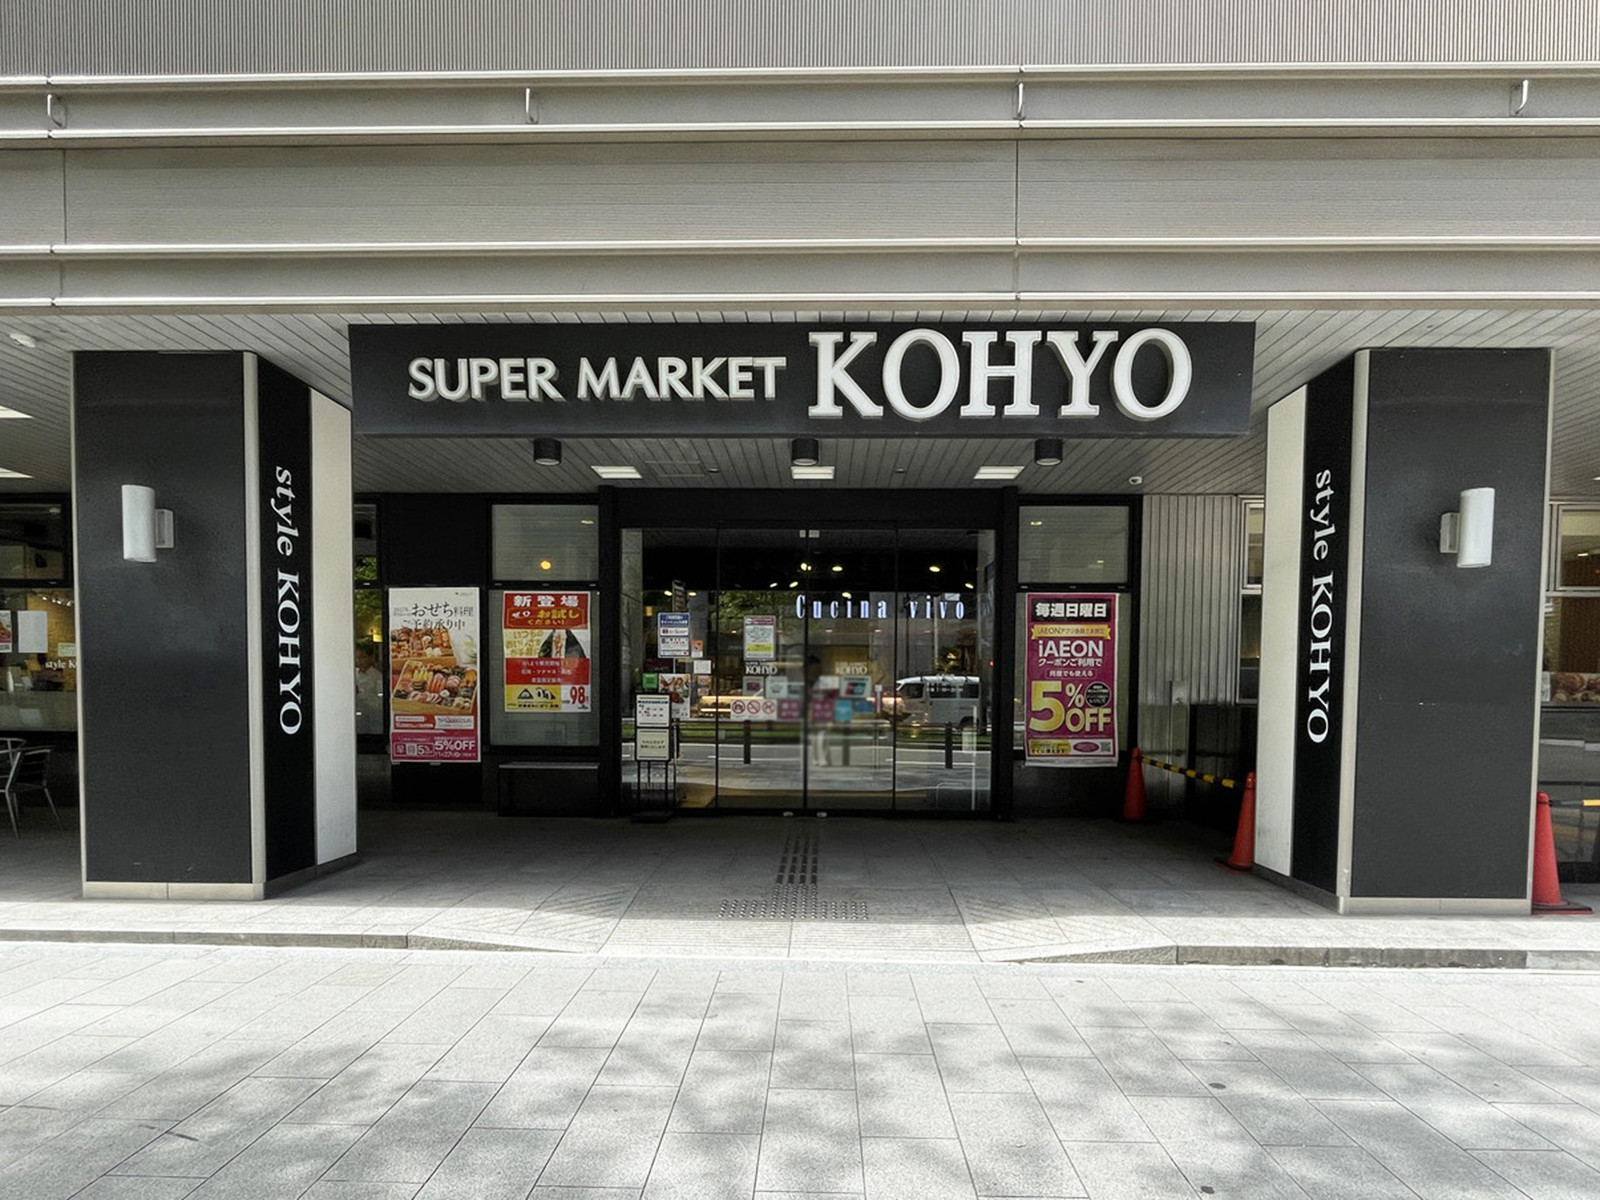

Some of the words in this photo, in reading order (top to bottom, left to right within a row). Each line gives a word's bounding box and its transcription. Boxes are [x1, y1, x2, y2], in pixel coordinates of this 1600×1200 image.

[408, 357, 562, 401] SUPER
[577, 356, 788, 400] MARKET
[808, 328, 1194, 421] KOHYO
[270, 466, 299, 557] style
[1309, 469, 1336, 561] style
[513, 594, 579, 607] 新登場
[795, 594, 888, 618] Cucina
[909, 594, 965, 618] vivo
[1035, 602, 1107, 618] 毎週日曜日
[277, 568, 303, 735] KOHYO
[1038, 640, 1103, 657] iAEON
[1307, 570, 1334, 743] KOHYO
[569, 686, 586, 704] 98
[1065, 707, 1112, 732] OFF
